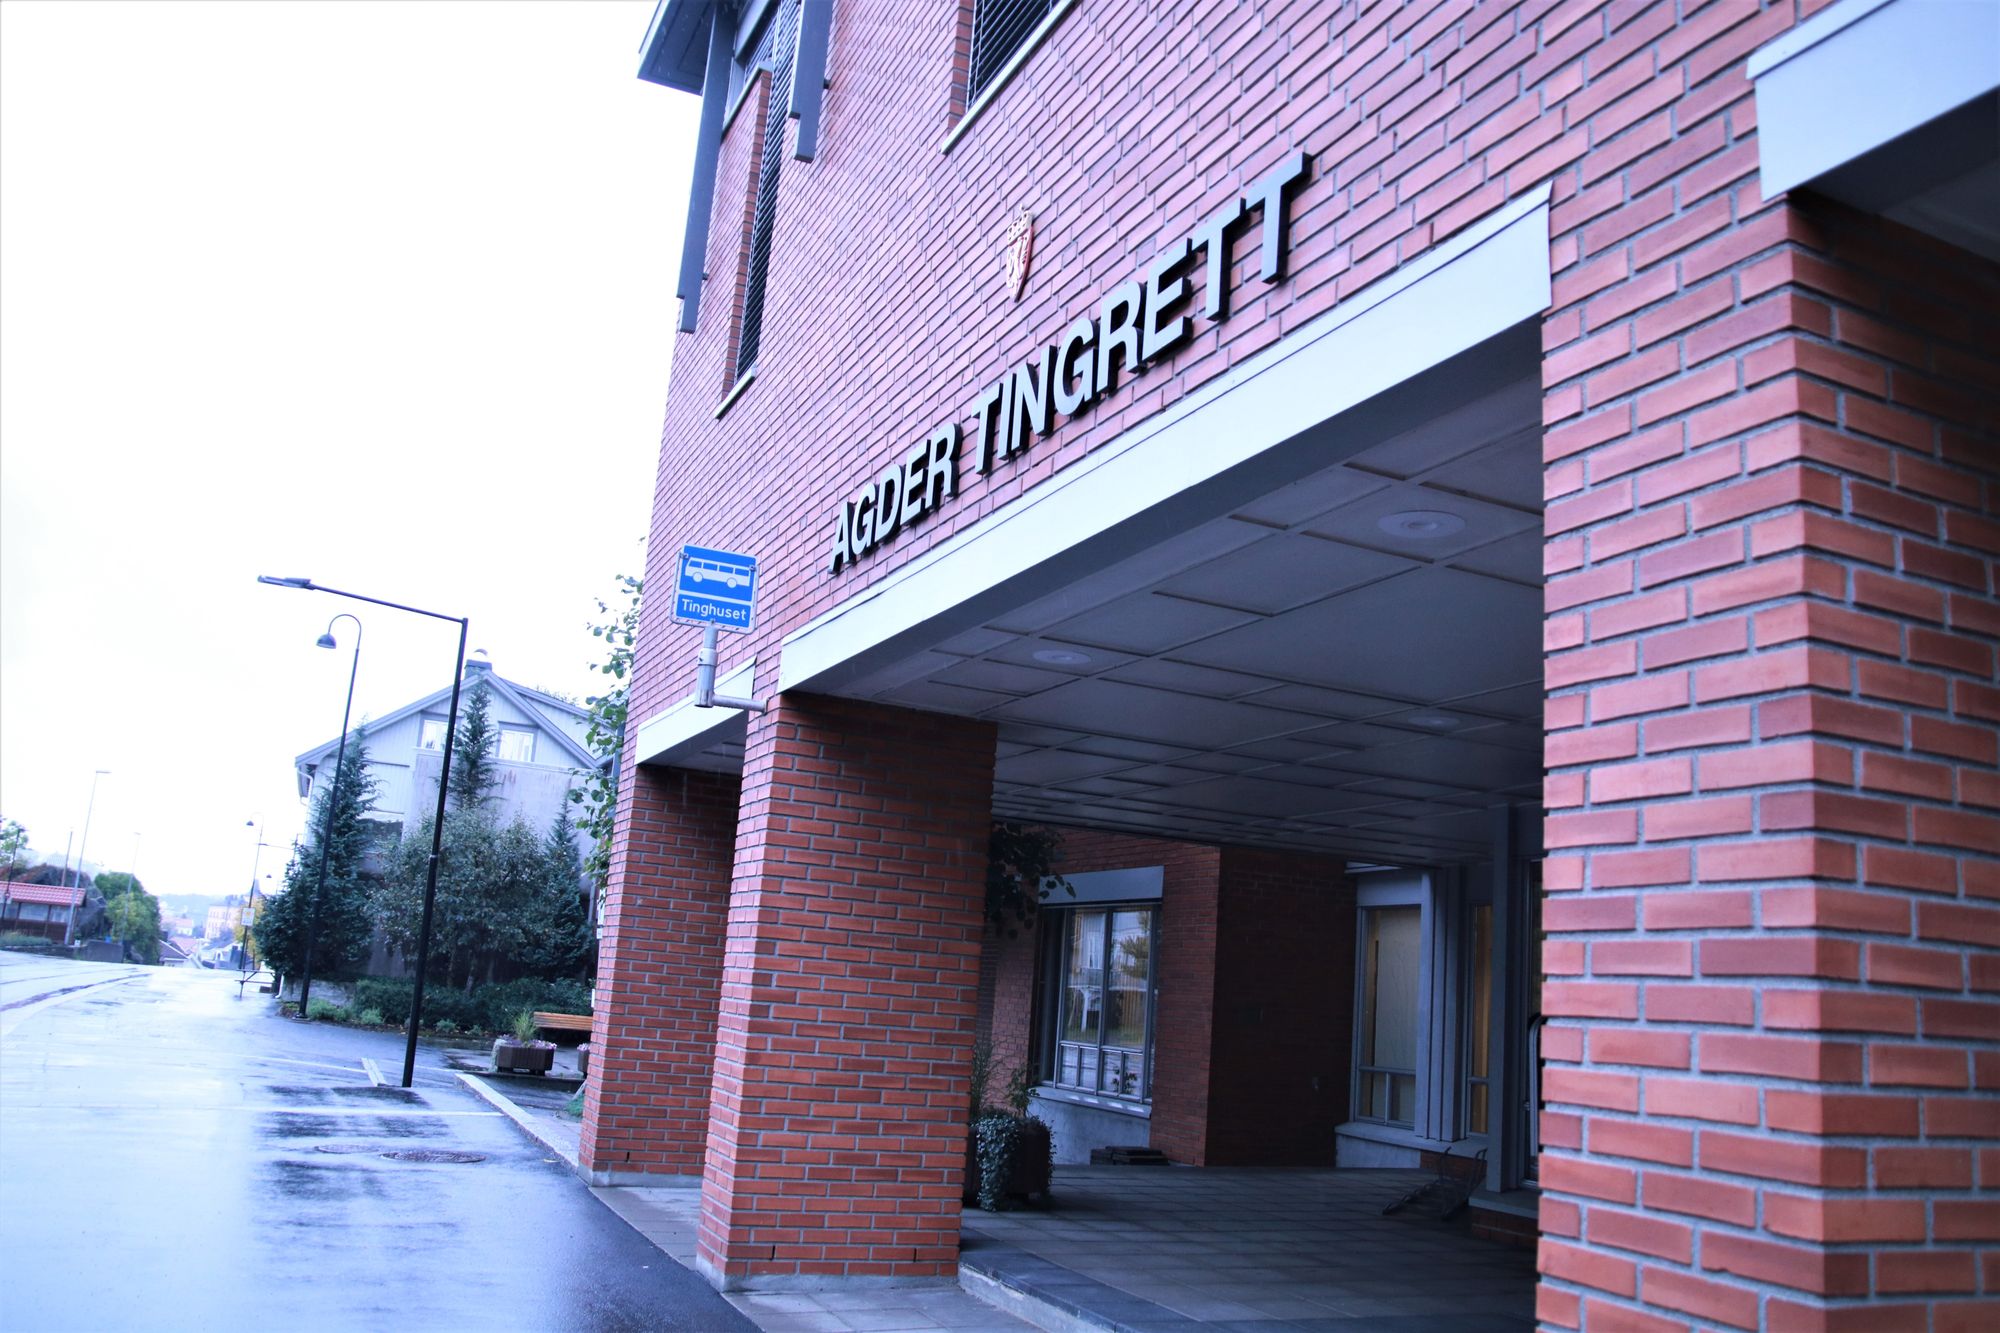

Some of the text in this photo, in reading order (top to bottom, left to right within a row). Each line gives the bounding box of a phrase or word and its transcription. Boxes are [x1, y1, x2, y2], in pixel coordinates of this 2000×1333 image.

[829, 151, 1313, 575] AGDER TINGRETT
[682, 599, 746, 620] Tinghuset
